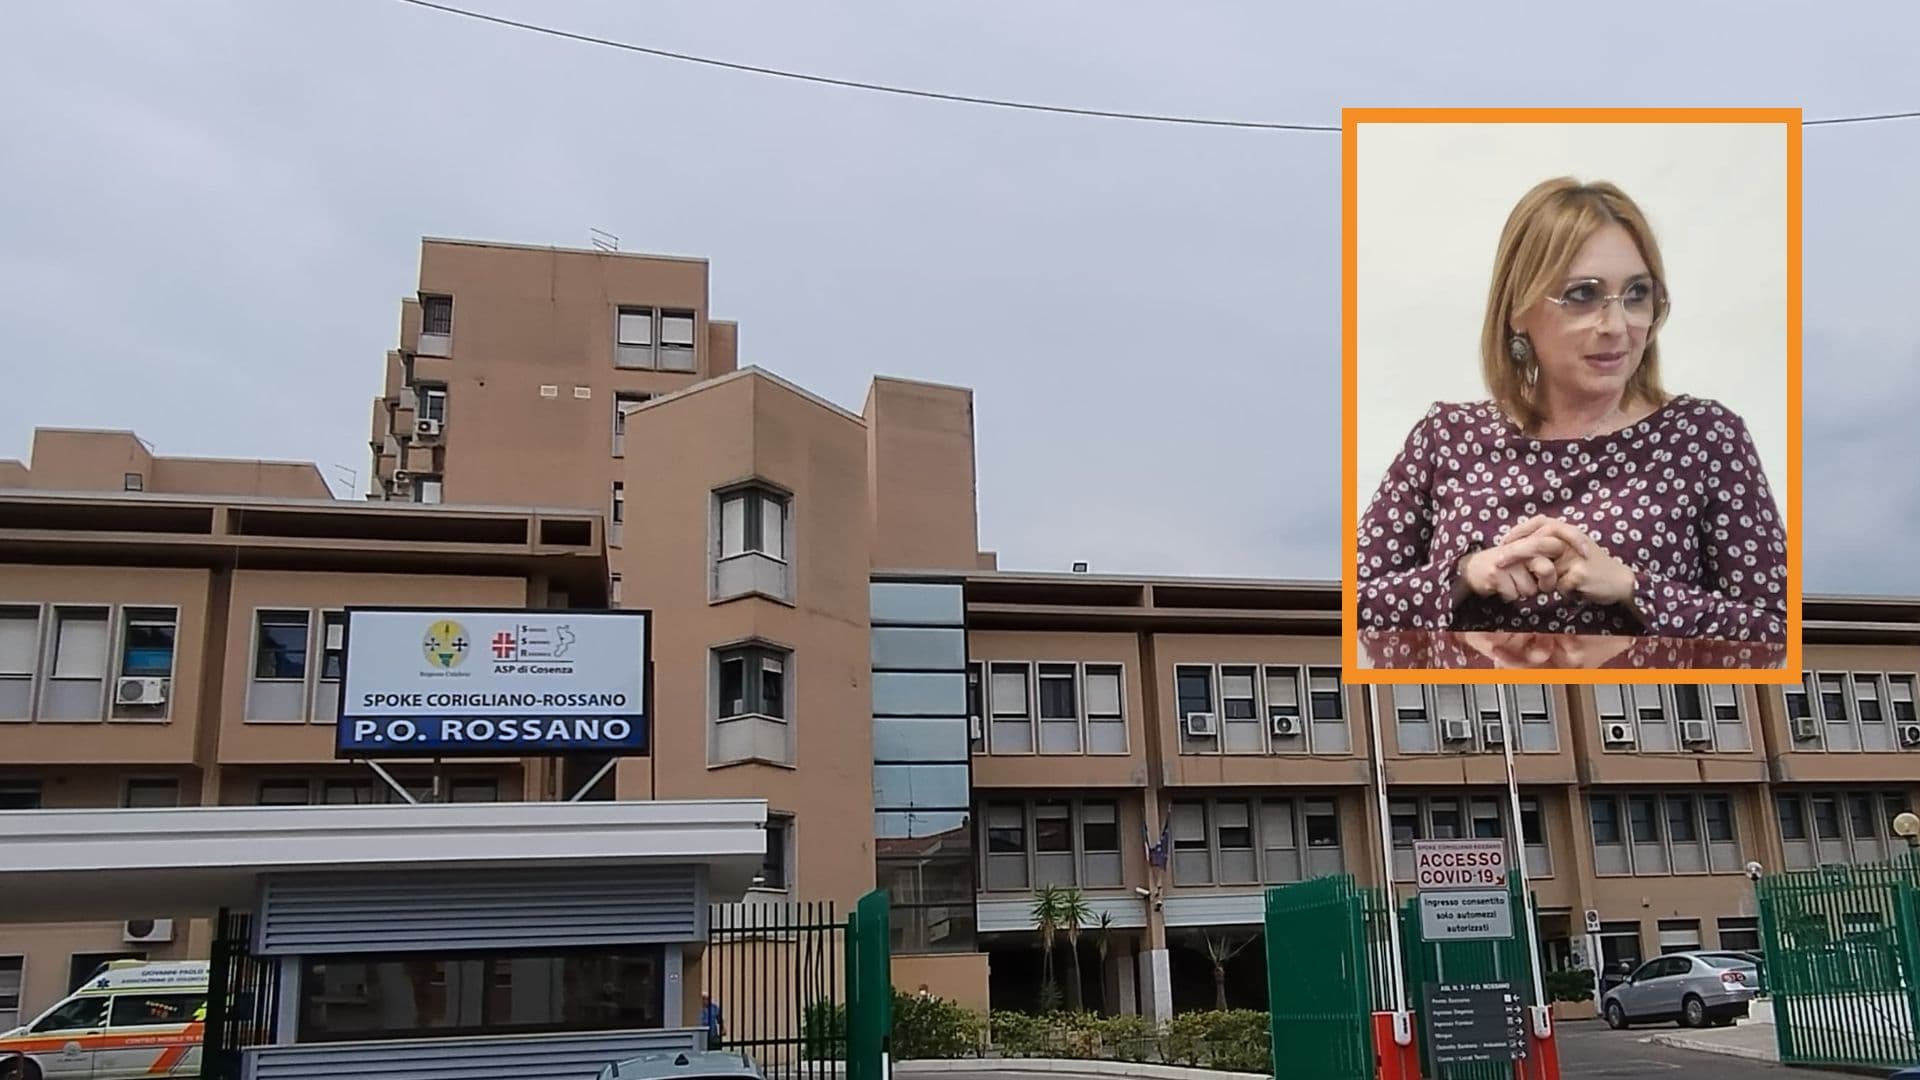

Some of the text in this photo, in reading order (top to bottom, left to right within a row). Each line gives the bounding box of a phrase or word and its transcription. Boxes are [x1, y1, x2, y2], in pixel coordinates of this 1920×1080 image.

[493, 664, 574, 675] ASP di Cosenza
[363, 693, 627, 707] SPOKE CORIGLIANO-ROSSANO
[354, 718, 632, 742] P.O. ROSSANO
[1419, 852, 1502, 867] ACCESSO
[1424, 896, 1505, 907] Ingresso consentito
[1436, 910, 1497, 920] solo automezzi
[1446, 924, 1490, 932] autorizzati
